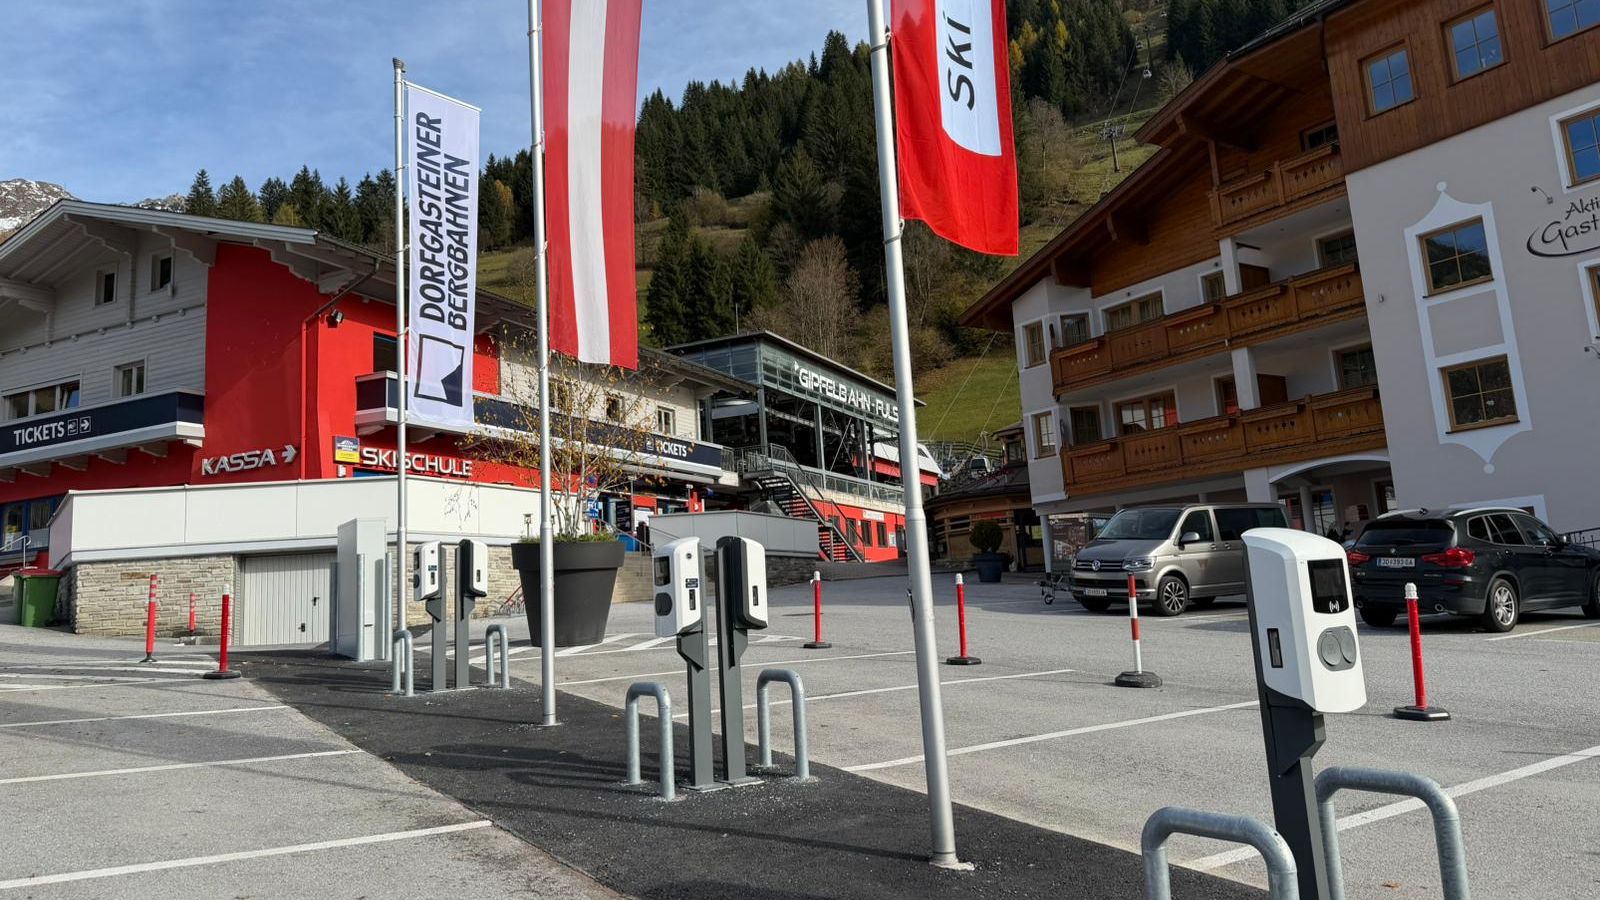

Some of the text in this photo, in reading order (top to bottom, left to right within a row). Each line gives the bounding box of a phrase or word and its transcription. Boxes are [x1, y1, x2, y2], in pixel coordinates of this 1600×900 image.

[416, 111, 446, 324] DORFGASTEINER
[443, 153, 470, 331] BERGBAHNEN
[13, 421, 65, 446] TICKETS
[201, 448, 276, 475] KASSA
